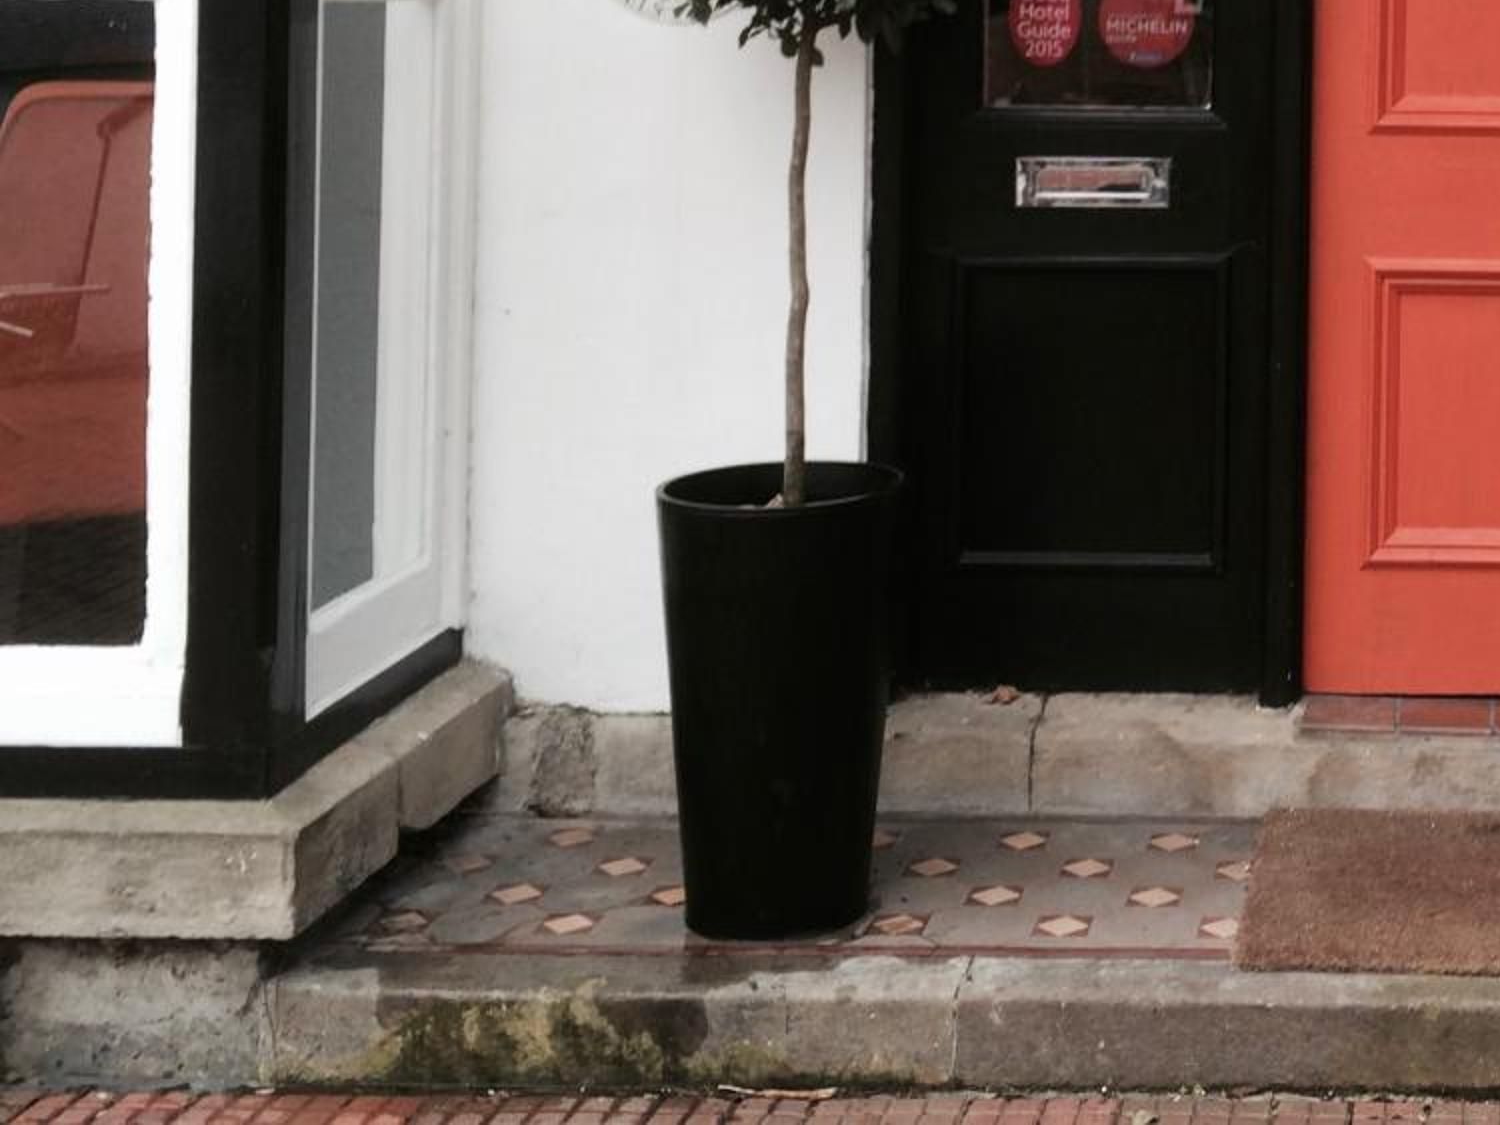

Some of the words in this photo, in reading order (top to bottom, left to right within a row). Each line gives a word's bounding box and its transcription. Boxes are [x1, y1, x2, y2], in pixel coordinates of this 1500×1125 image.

[1019, 1, 1070, 21] Hotel
[1017, 20, 1072, 39] Guide
[1105, 16, 1188, 37] MICHELIN
[1025, 40, 1064, 58] 2015
